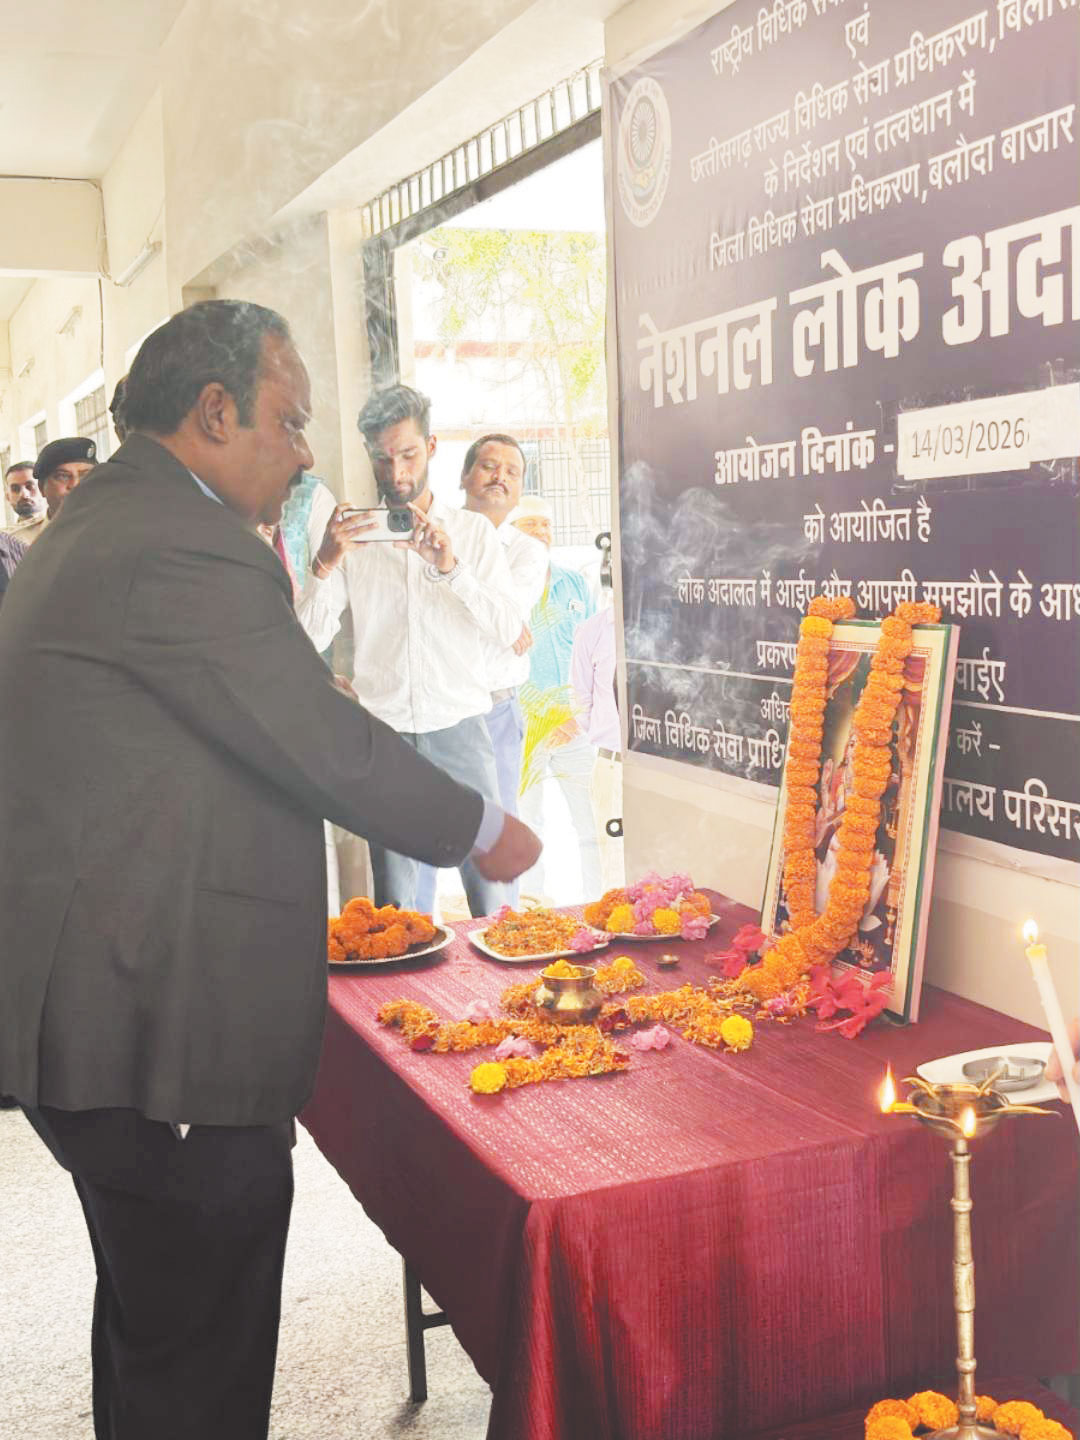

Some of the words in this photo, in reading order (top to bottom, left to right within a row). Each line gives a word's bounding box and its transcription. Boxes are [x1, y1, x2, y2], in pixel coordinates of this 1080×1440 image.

[711, 25, 754, 76] राष्ट्रीय
[757, 0, 808, 51] विधिक
[845, 3, 871, 59] एवं
[753, 110, 791, 153] राज्य
[794, 80, 849, 136] विधिक
[763, 158, 780, 198] के
[783, 141, 841, 194] निर्देशन
[844, 118, 870, 171] एवं
[957, 69, 977, 118] में
[709, 232, 745, 272] जिला
[748, 211, 798, 259] विधिक
[801, 195, 834, 238] सेवा
[928, 134, 996, 191] बलौदा
[1001, 104, 1077, 165] बाजार
[636, 296, 778, 409] नेशनल
[788, 247, 925, 379] लोक
[713, 435, 797, 486] आयोजन
[801, 420, 877, 477] दिनांक
[911, 417, 1025, 460] 14/03/2026
[804, 503, 827, 545] को
[829, 497, 912, 544] आयोजित
[915, 495, 932, 544] है
[678, 570, 705, 604] लोक
[707, 577, 757, 608] अदालत
[761, 570, 773, 609] में
[923, 568, 1004, 619] समझौते
[1008, 568, 1033, 619] के
[631, 703, 661, 746] जिला
[664, 709, 710, 756] विधिक
[711, 721, 743, 766] सेवा
